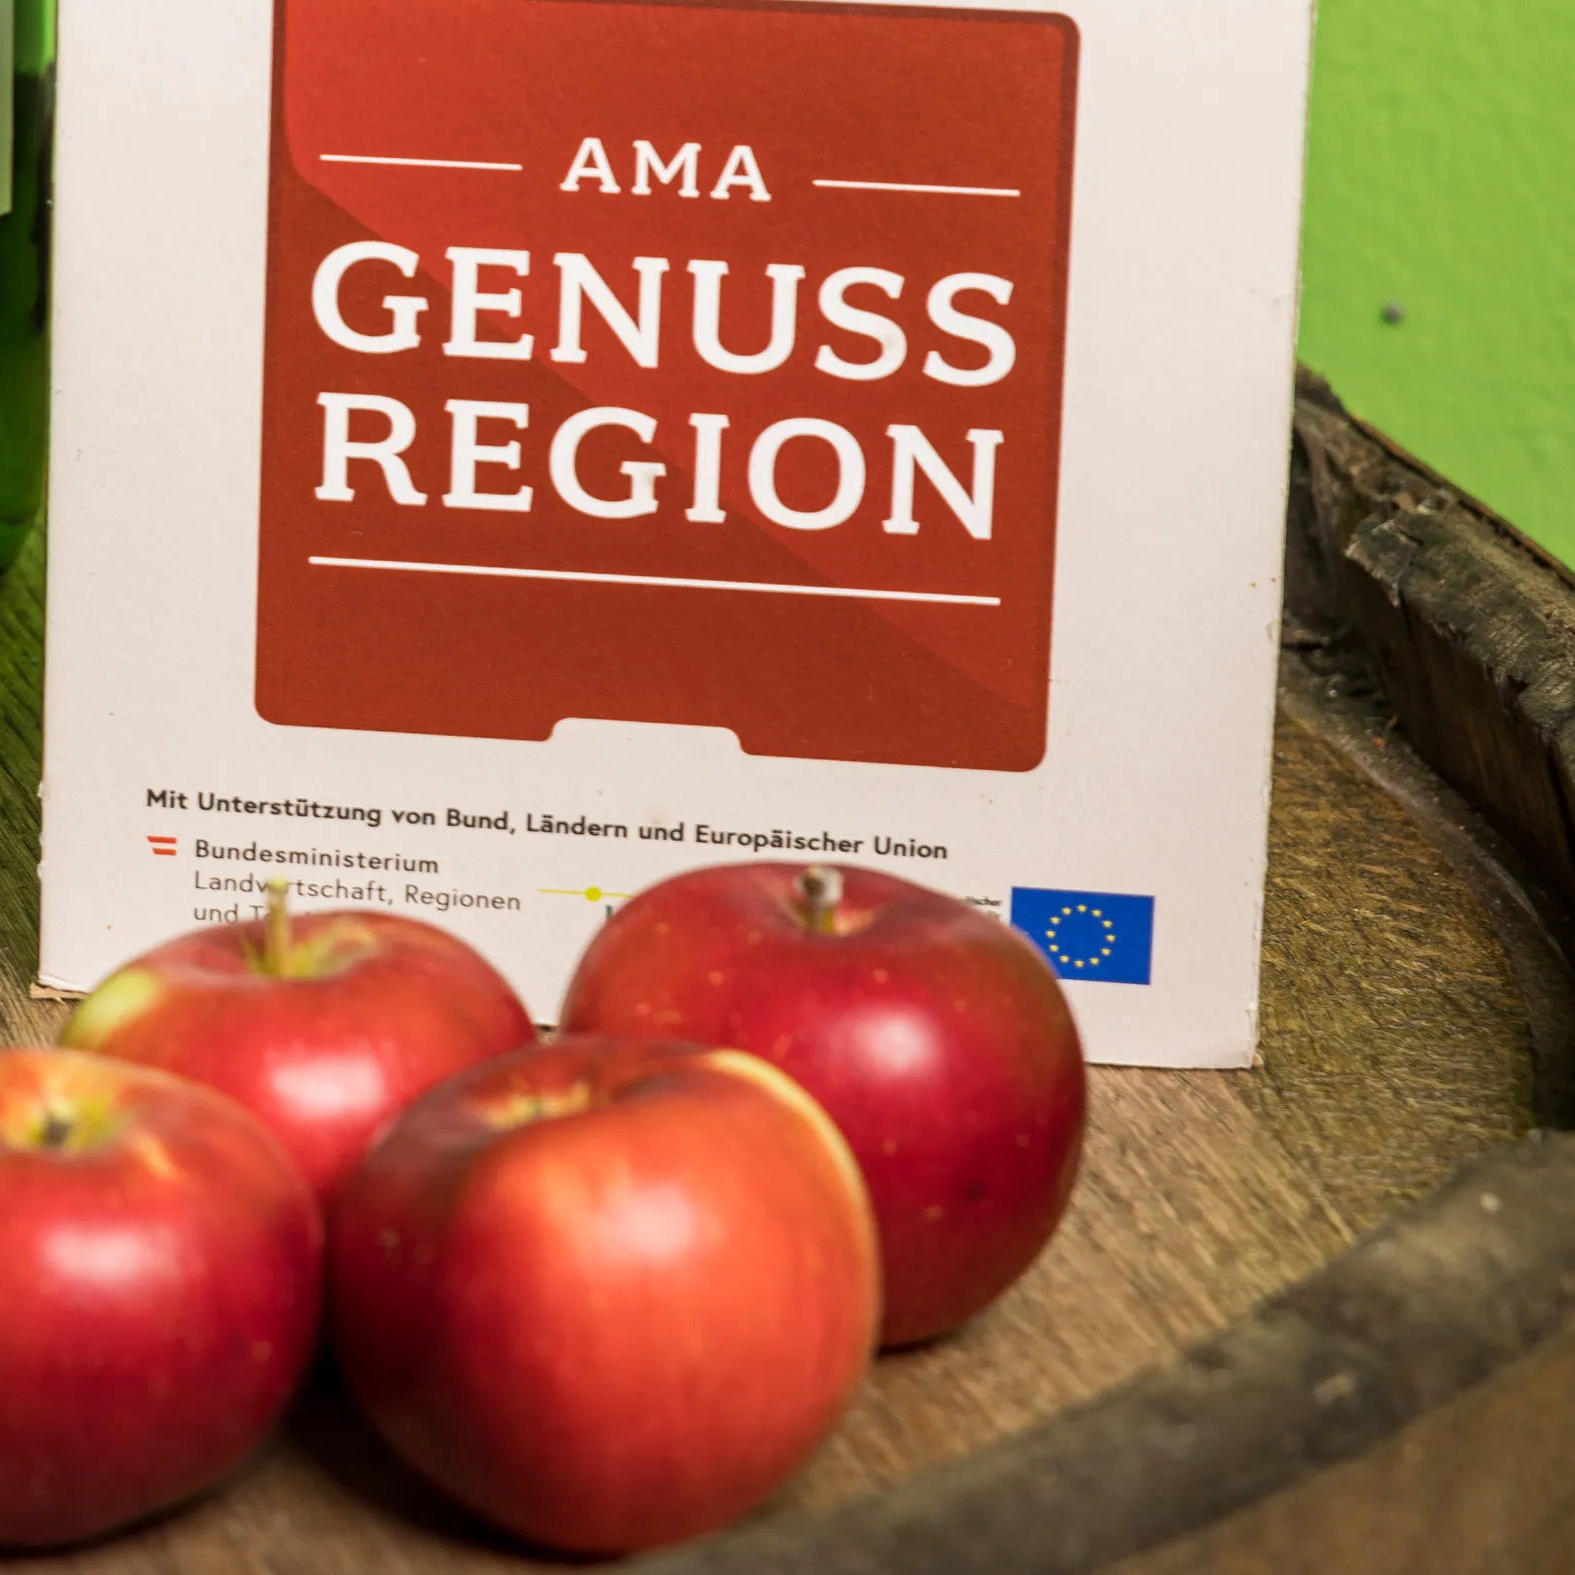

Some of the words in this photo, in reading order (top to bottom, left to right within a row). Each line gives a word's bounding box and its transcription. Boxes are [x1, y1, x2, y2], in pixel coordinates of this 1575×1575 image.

[559, 137, 772, 202] AMA
[312, 240, 1016, 388] GENUSS
[314, 391, 1004, 540] REGION
[146, 788, 188, 810] Mit
[197, 791, 382, 828] Unterstützung
[390, 809, 436, 826] von
[446, 807, 516, 835] Bund,
[526, 812, 628, 839] Ländern
[638, 821, 685, 842] und
[695, 823, 865, 854] Europäischer
[873, 835, 948, 860] Union
[195, 838, 439, 874] Bundesministerium
[193, 903, 239, 922] und
[405, 884, 521, 912] Regionen
